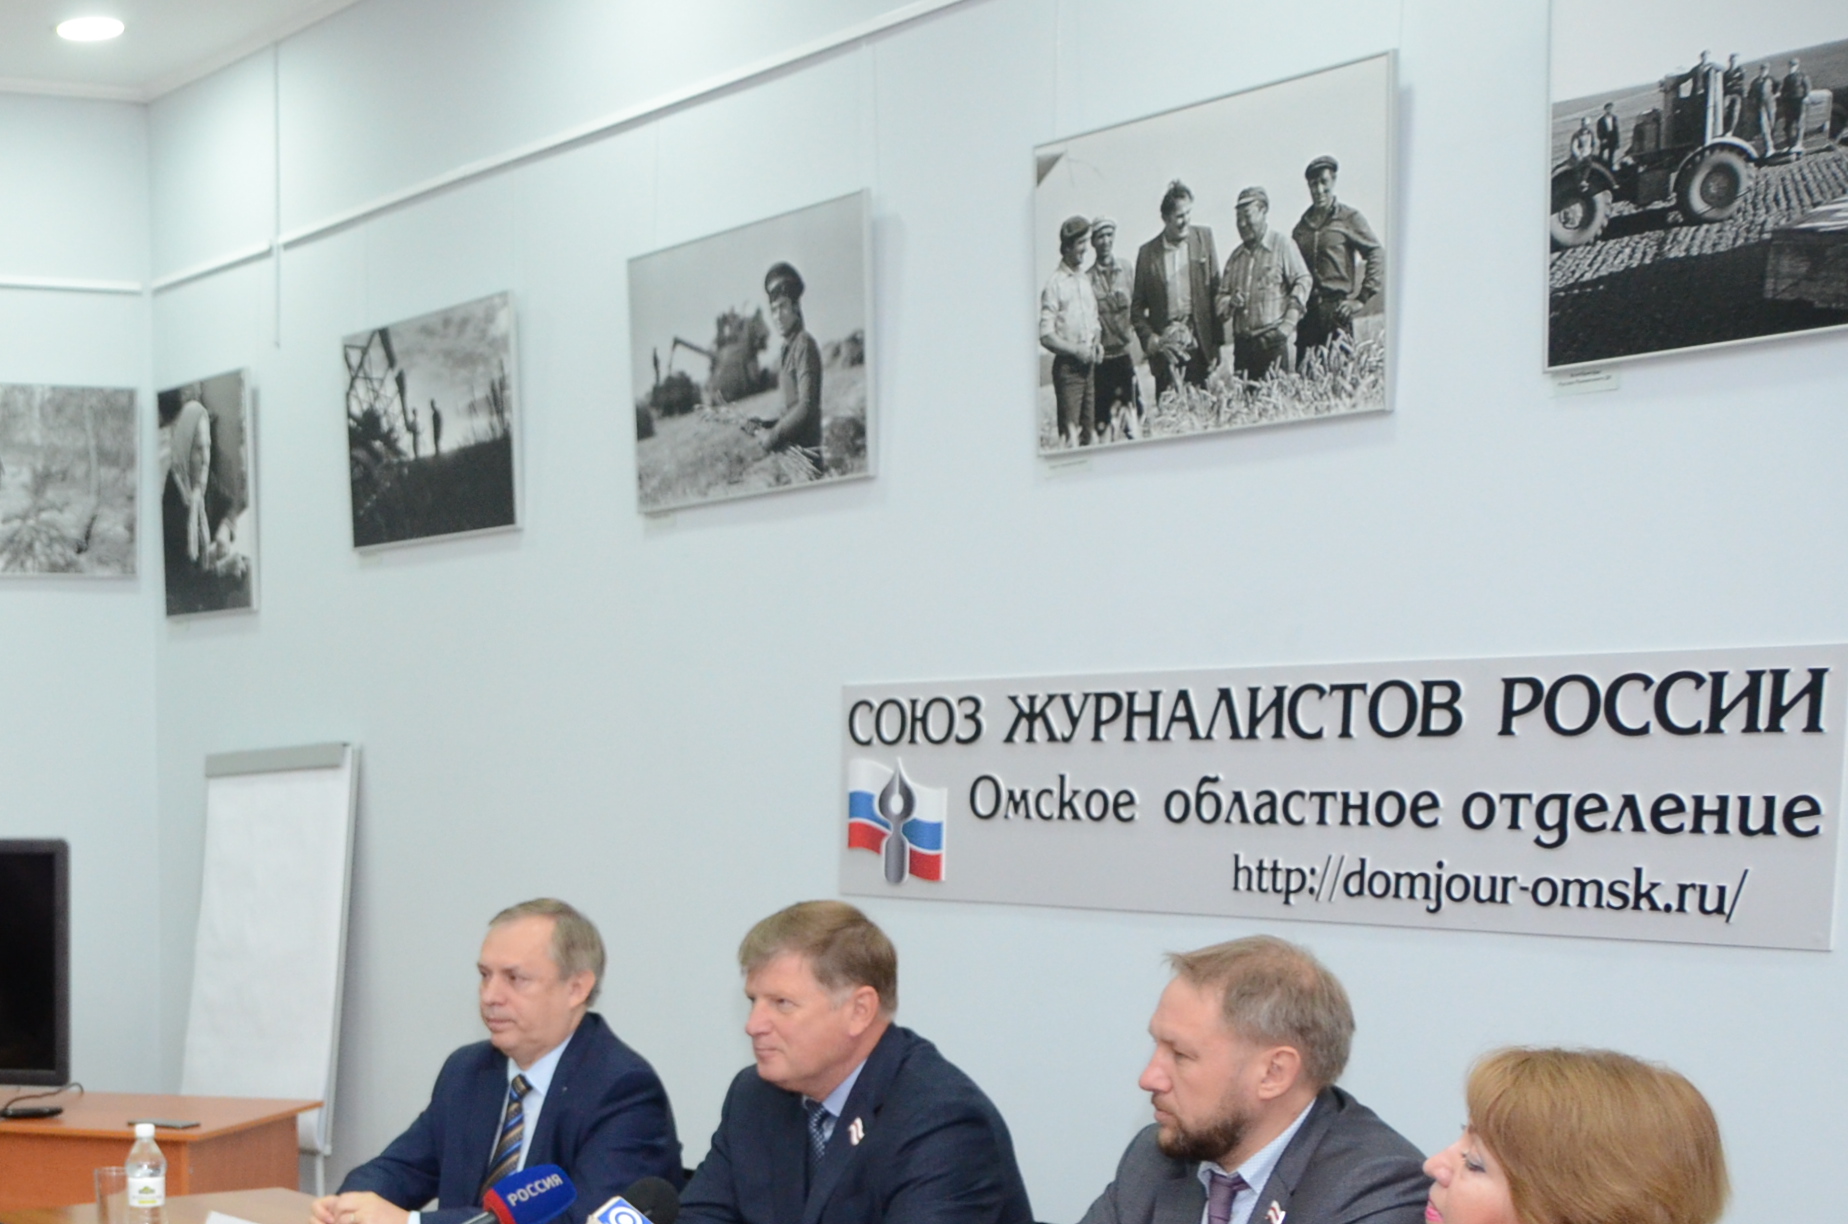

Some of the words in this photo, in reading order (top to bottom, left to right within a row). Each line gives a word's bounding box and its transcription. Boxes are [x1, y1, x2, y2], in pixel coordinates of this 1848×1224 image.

[847, 695, 984, 746] СОЮЗ
[1003, 680, 1464, 744] ЖУРНАЛИСТОВ
[1497, 666, 1830, 737] РОССИИ
[968, 773, 1137, 823] Омское
[1163, 775, 1441, 829] областное
[1461, 790, 1823, 849] отделение
[1232, 852, 1750, 924] http://domjour-omsk.ru/
[506, 1173, 564, 1207] РОССИЯ
